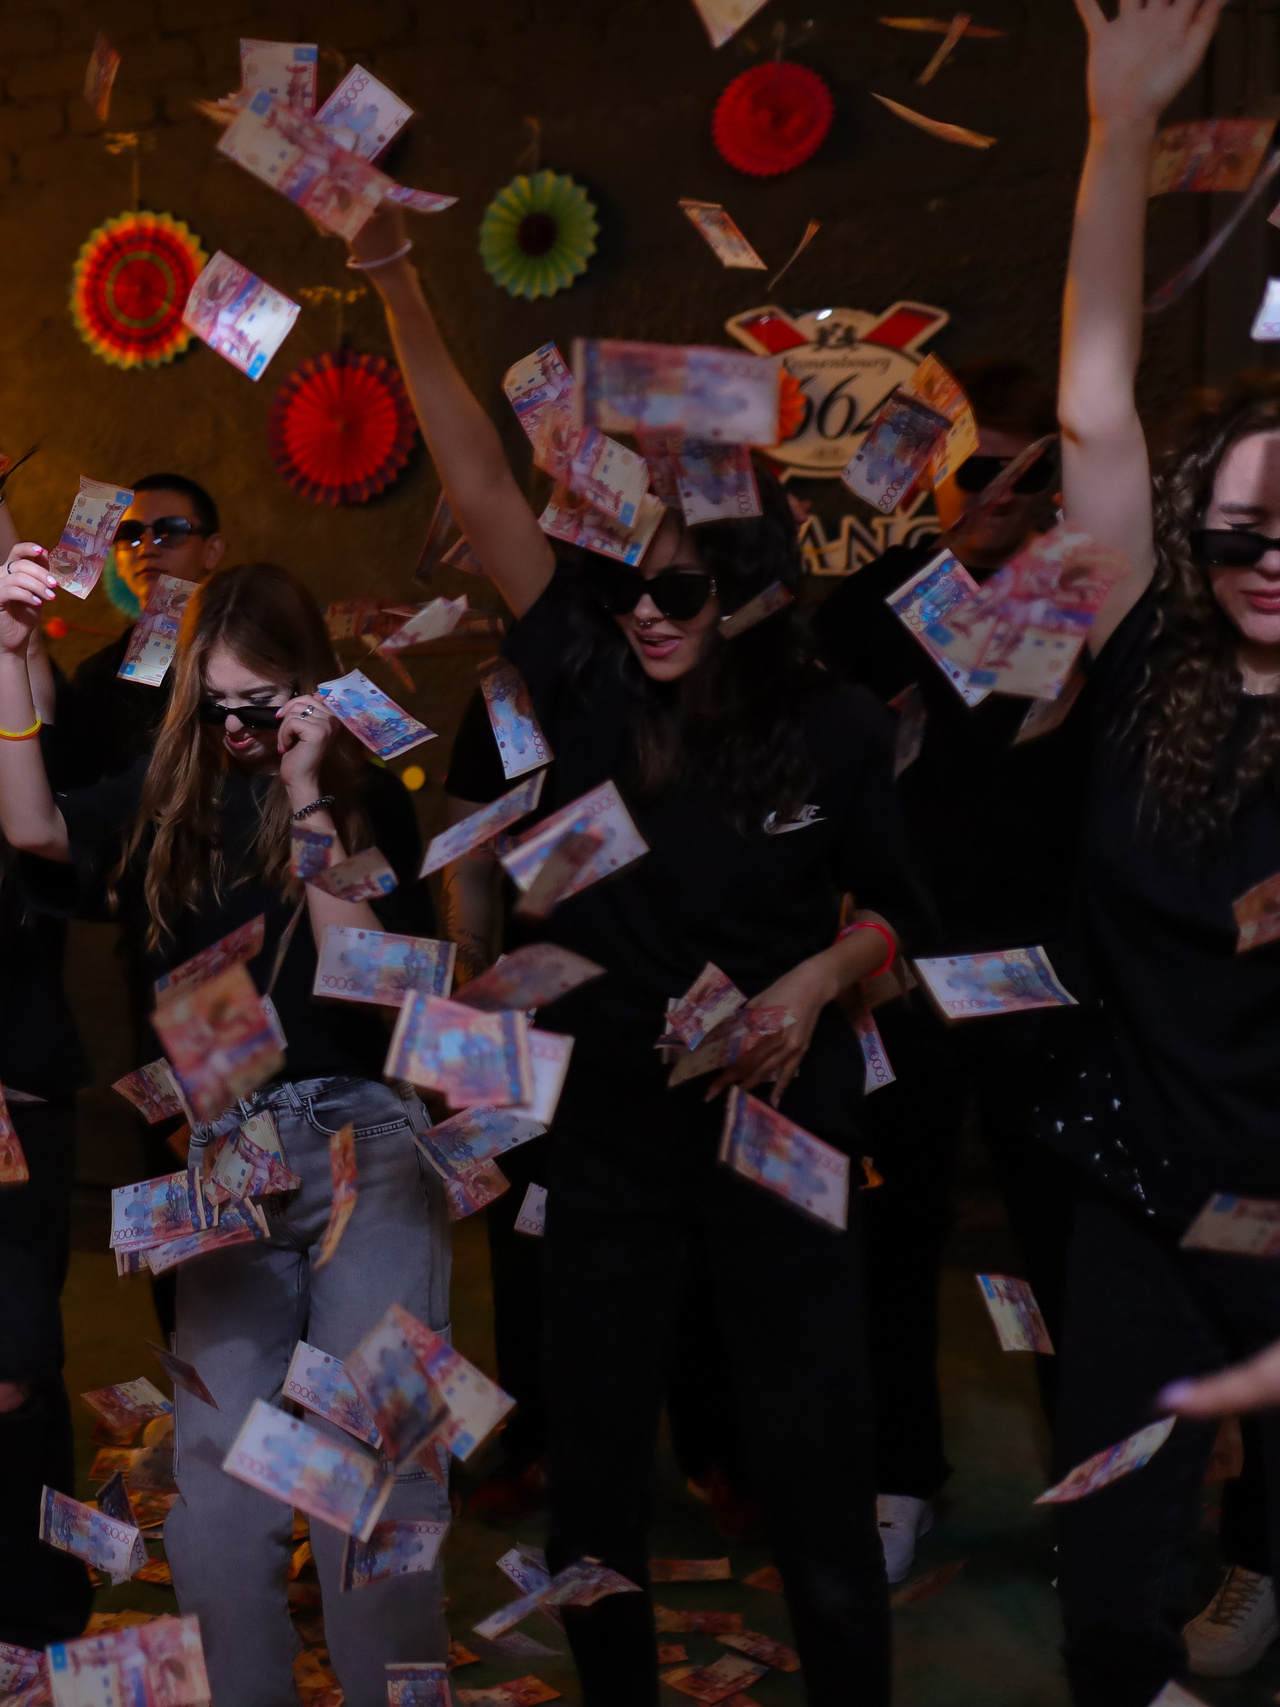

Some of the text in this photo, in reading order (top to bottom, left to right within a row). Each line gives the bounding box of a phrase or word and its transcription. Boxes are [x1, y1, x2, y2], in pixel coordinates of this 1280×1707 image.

[338, 74, 370, 113] 5000
[878, 478, 905, 511] 5000
[532, 727, 547, 760] 5000
[321, 975, 358, 991] 5000
[868, 1050, 889, 1083] 5000
[113, 1226, 143, 1241] 5000
[288, 1381, 318, 1403] 5000
[103, 1525, 131, 1545] 5000
[414, 1523, 442, 1535] 5000
[502, 1559, 528, 1585] 5000
